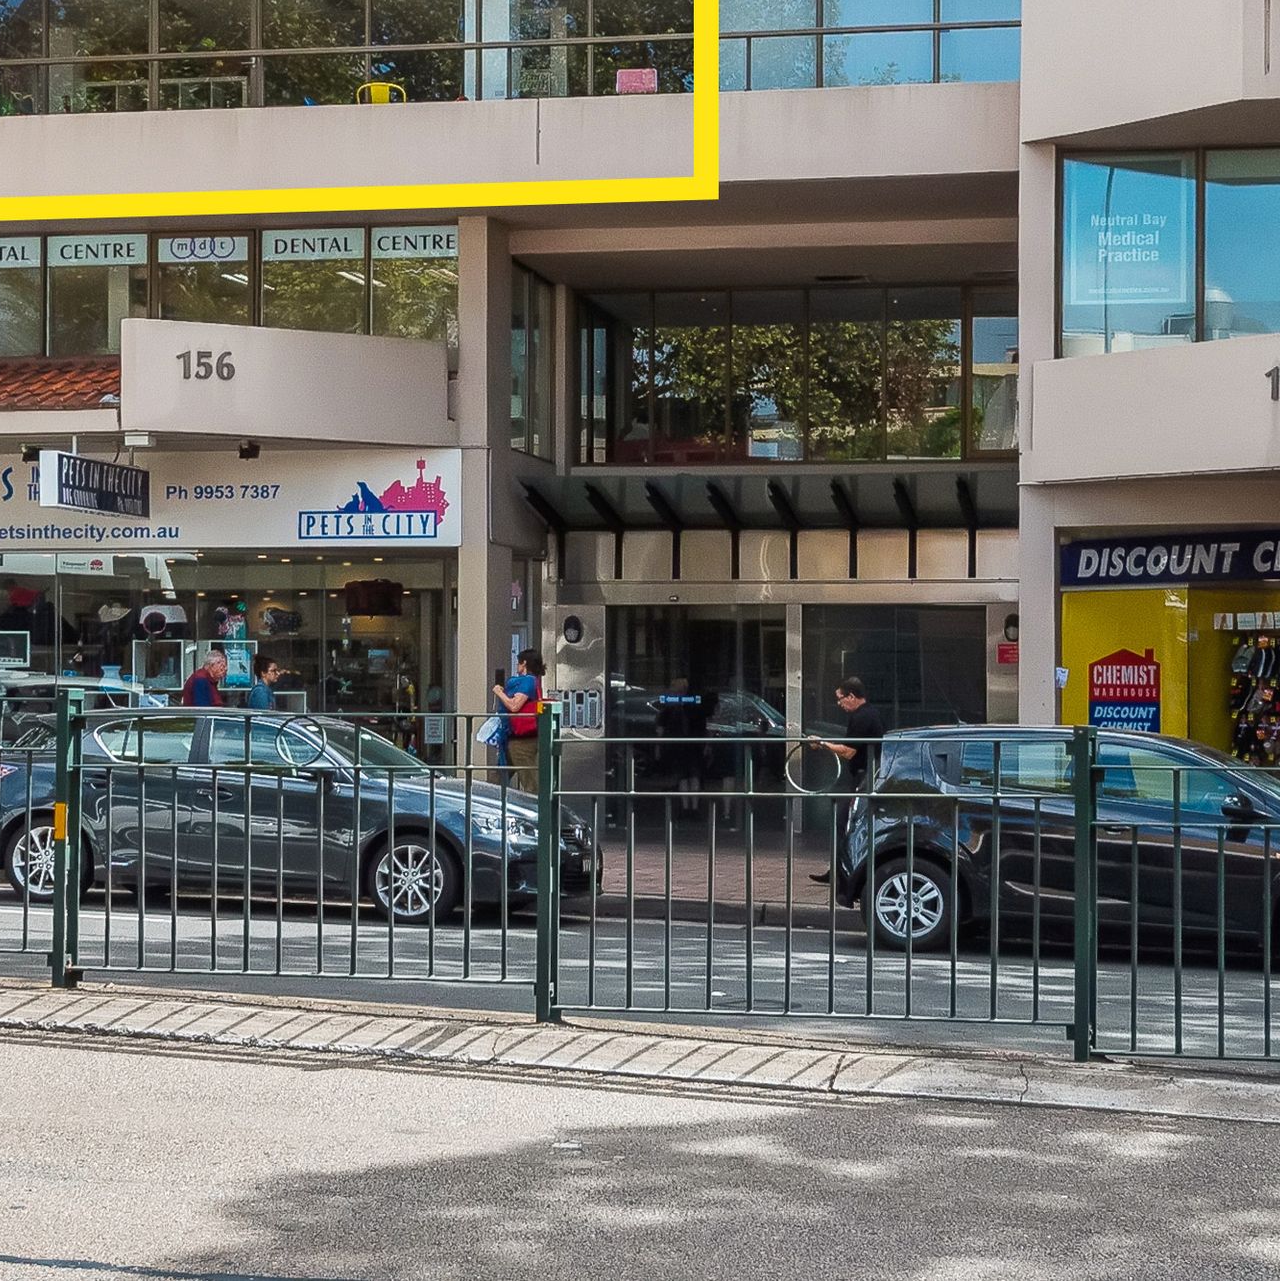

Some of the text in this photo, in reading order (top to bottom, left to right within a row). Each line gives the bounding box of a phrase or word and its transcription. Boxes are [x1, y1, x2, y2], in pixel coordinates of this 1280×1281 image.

[1090, 213, 1168, 228] Neutral Bay
[59, 241, 136, 259] CENTRE
[273, 235, 354, 255] DENTAL
[377, 232, 457, 251] CENTRE
[1098, 230, 1160, 247] Medical
[1098, 248, 1160, 263] Practice
[176, 350, 236, 382] 156
[62, 457, 144, 497] PETS IN THE CITY
[27, 483, 40, 501] TH
[165, 484, 280, 500] Ph 9953 7387
[306, 515, 354, 536] PETS
[364, 515, 373, 525] IN
[381, 514, 430, 535] CITY
[362, 525, 375, 535] THE
[1076, 542, 1240, 578] DISCOUNT
[1093, 664, 1157, 686] CHEMIST
[1093, 687, 1157, 697] WAREHOUSE
[1094, 706, 1157, 718] DISCOUNT
